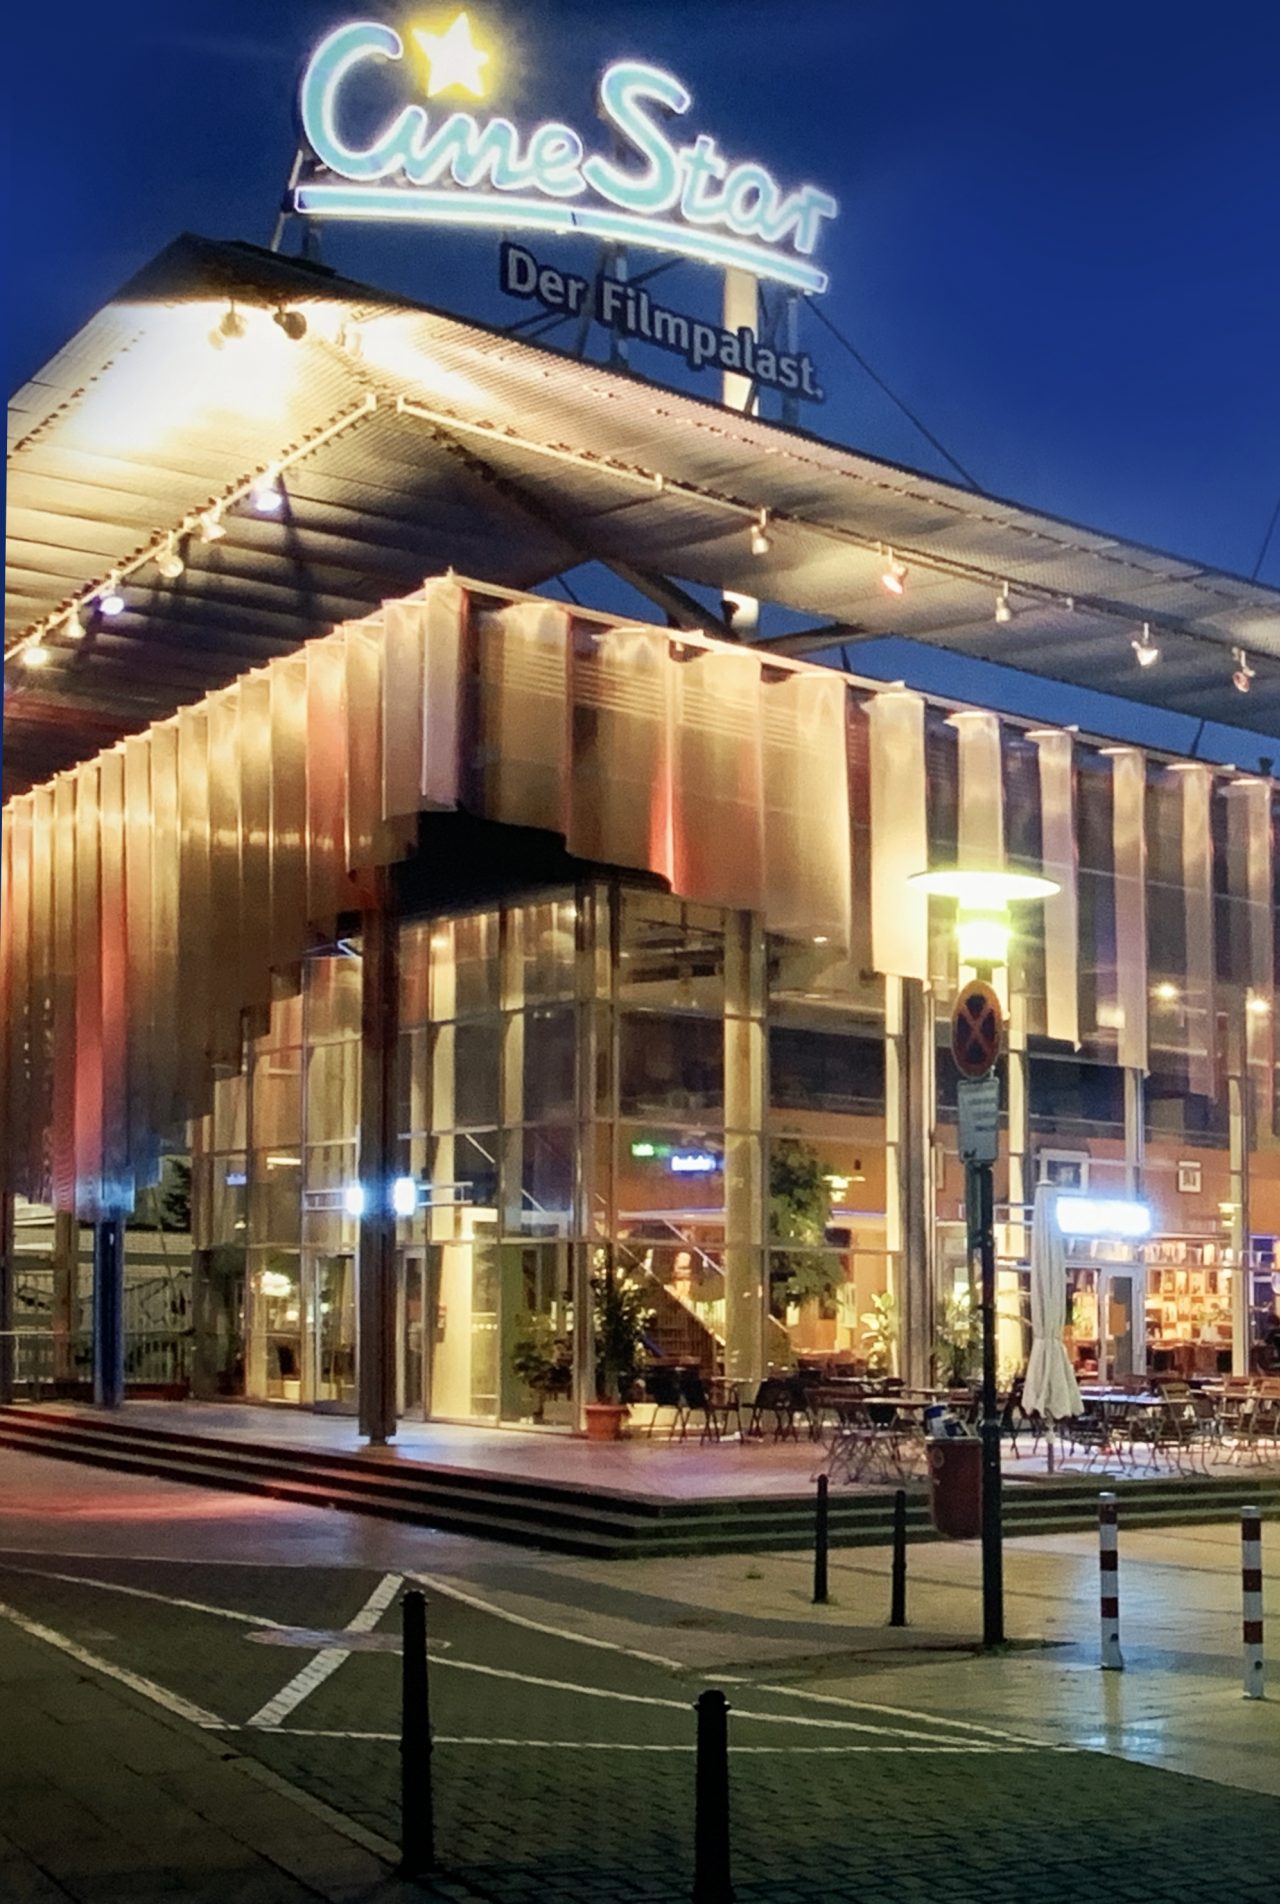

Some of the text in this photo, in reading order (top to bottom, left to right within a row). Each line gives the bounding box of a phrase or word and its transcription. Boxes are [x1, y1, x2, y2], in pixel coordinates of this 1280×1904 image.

[302, 20, 838, 254] CineStar
[507, 248, 824, 398] Der Filmpalast.
